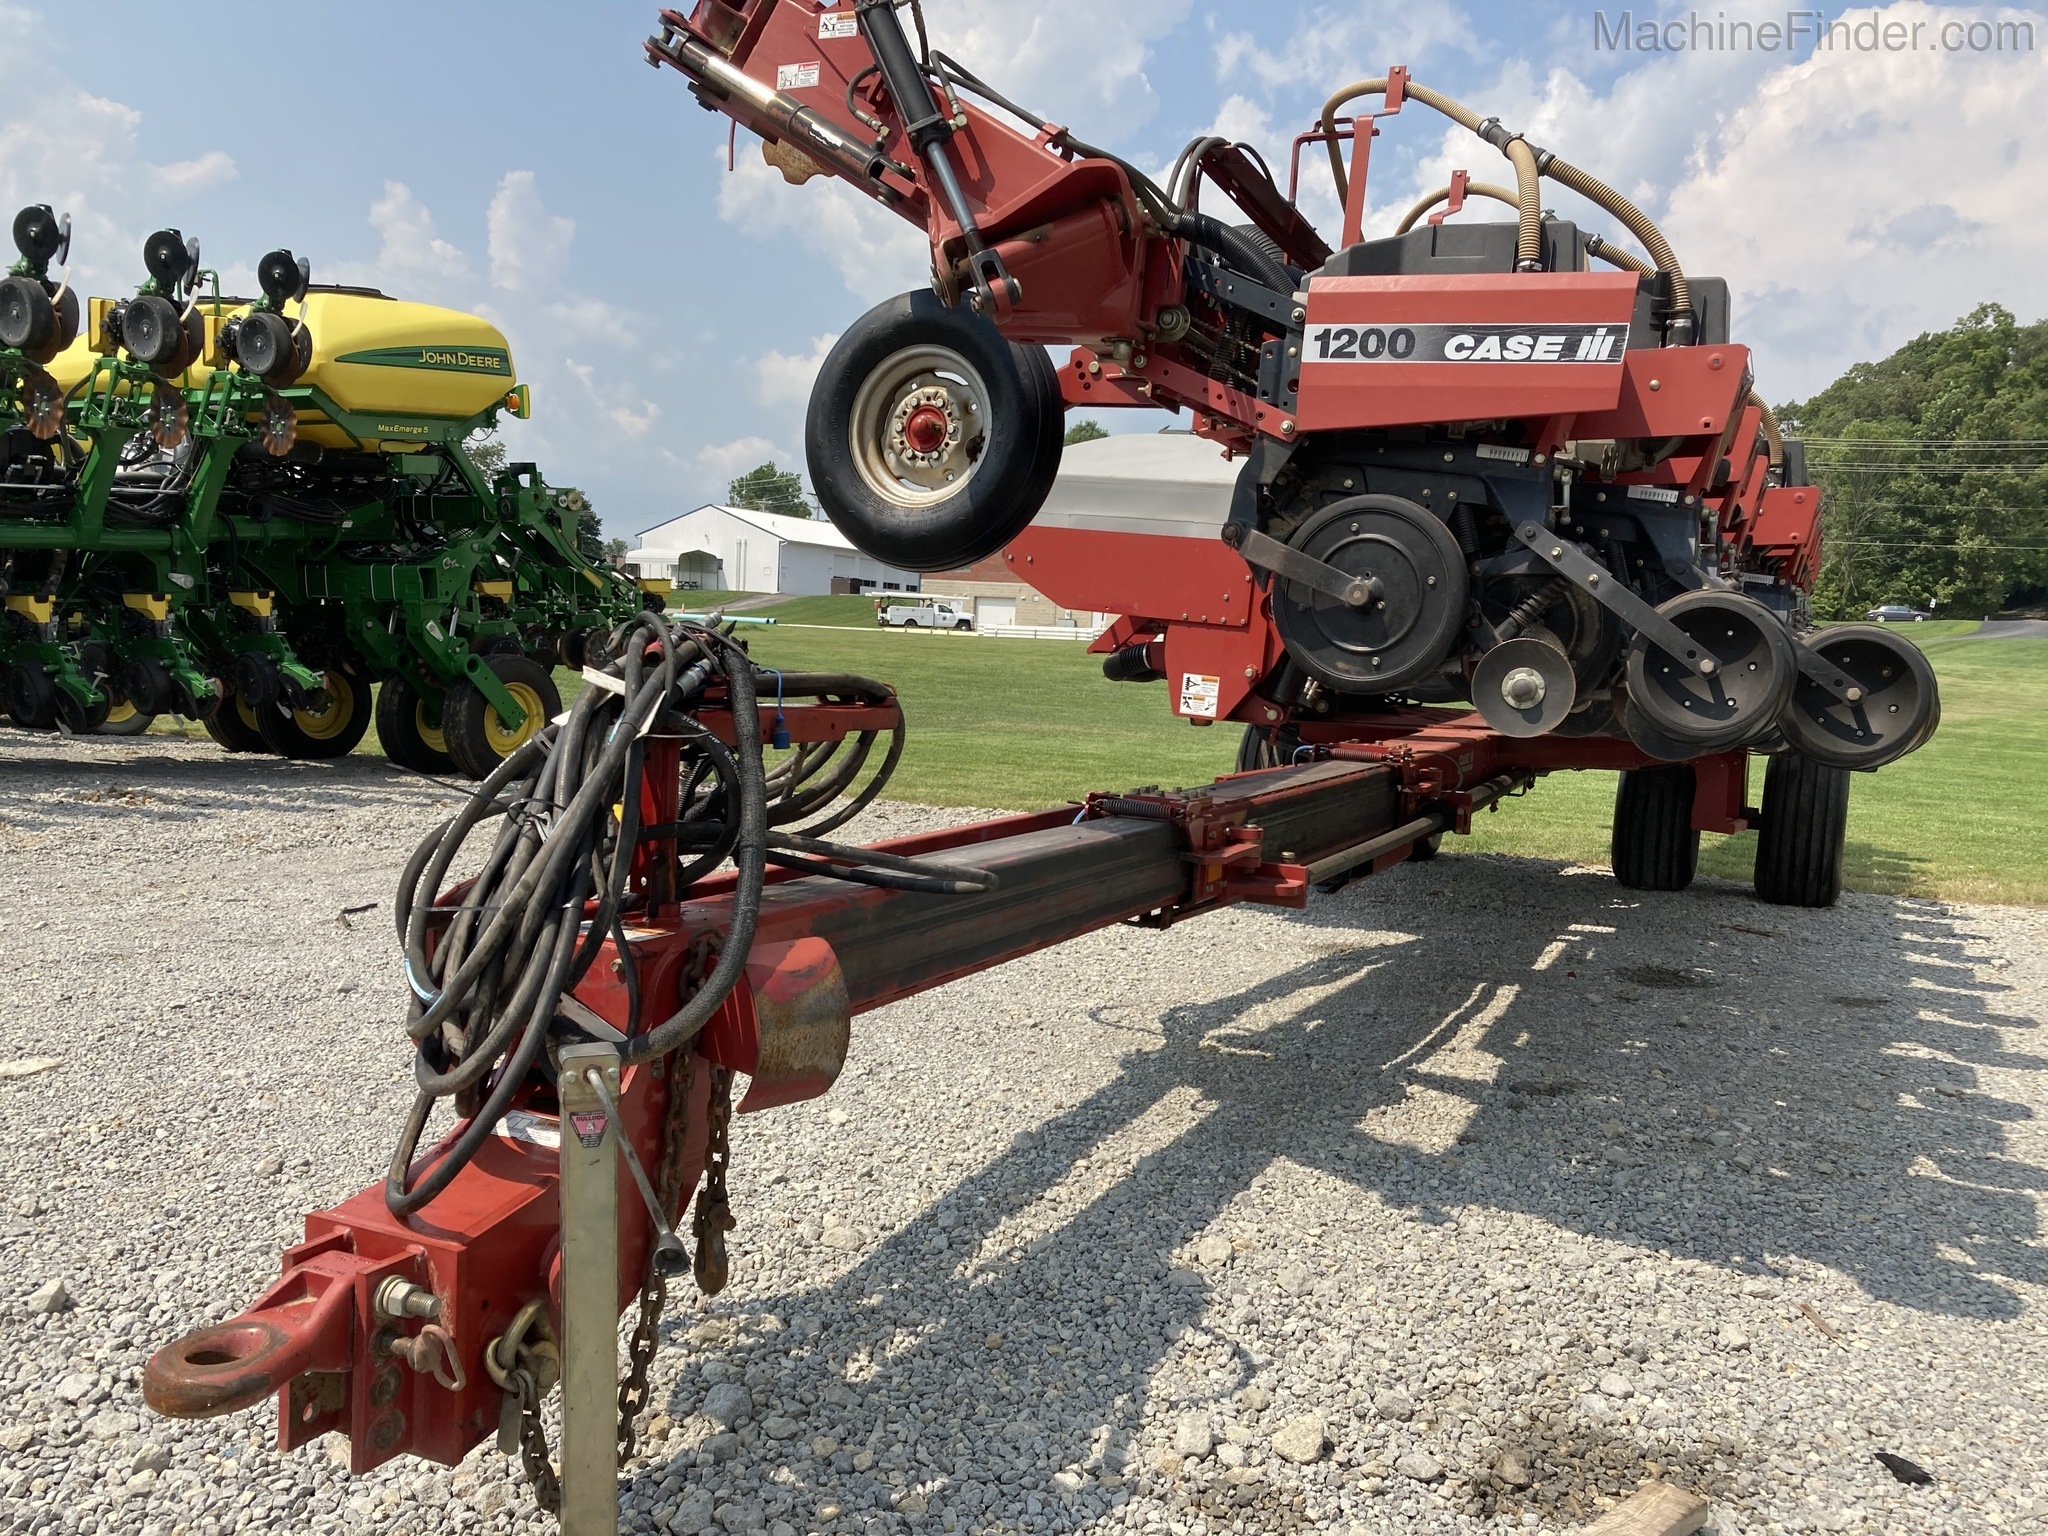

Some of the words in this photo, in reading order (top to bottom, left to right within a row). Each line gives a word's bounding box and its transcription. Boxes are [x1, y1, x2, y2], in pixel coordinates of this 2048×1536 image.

[1313, 327, 1416, 359] 1200
[1443, 334, 1567, 361] CASE
[418, 350, 456, 365] JOHN
[458, 352, 501, 369] DEERE
[377, 424, 423, 435] MaxEmerge
[423, 426, 429, 434] 5
